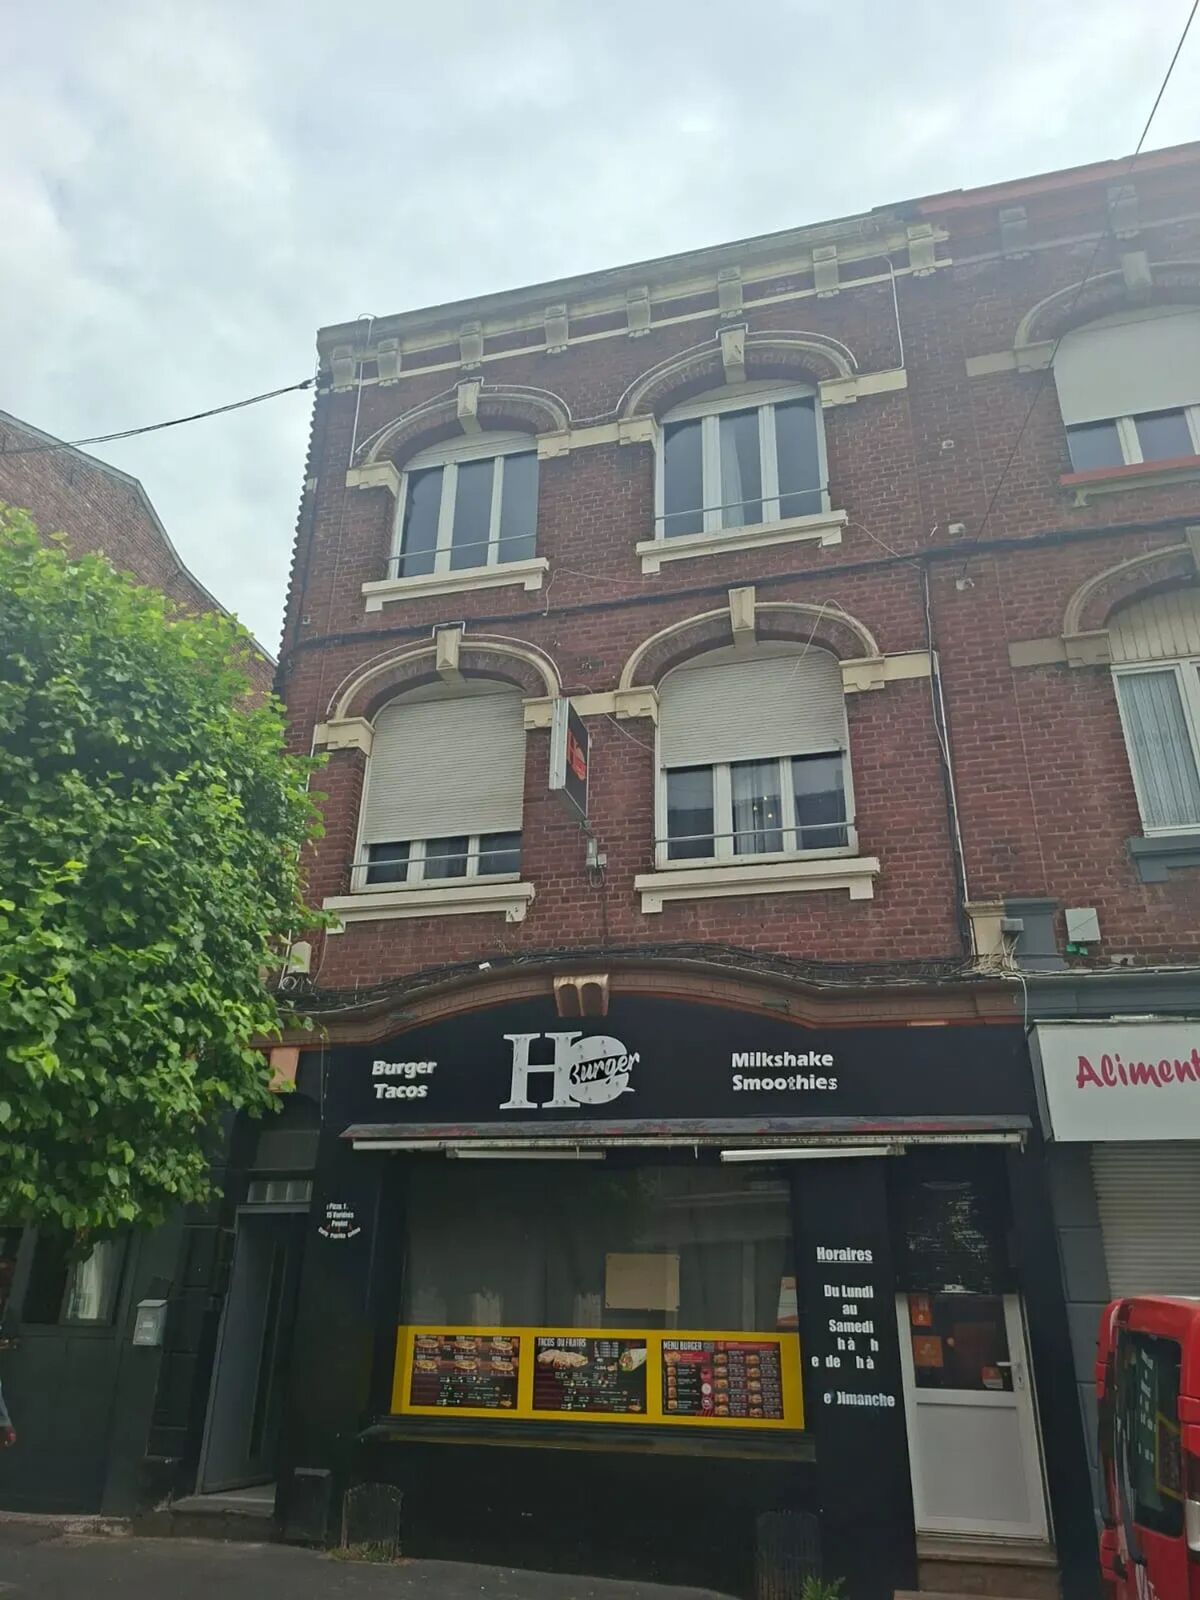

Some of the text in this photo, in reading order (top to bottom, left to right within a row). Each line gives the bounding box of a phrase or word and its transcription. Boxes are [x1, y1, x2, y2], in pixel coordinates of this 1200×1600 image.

[731, 1051, 834, 1068] Milkshake
[372, 1060, 438, 1079] Burger
[732, 1074, 838, 1091] Smoothies
[373, 1083, 429, 1099] Tacos
[816, 1247, 873, 1262] Horaires
[824, 1284, 874, 1299] Du Lundi
[842, 1304, 858, 1316] au
[828, 1319, 874, 1333] Samedi
[663, 1340, 679, 1351] MENU
[825, 1354, 841, 1368] de
